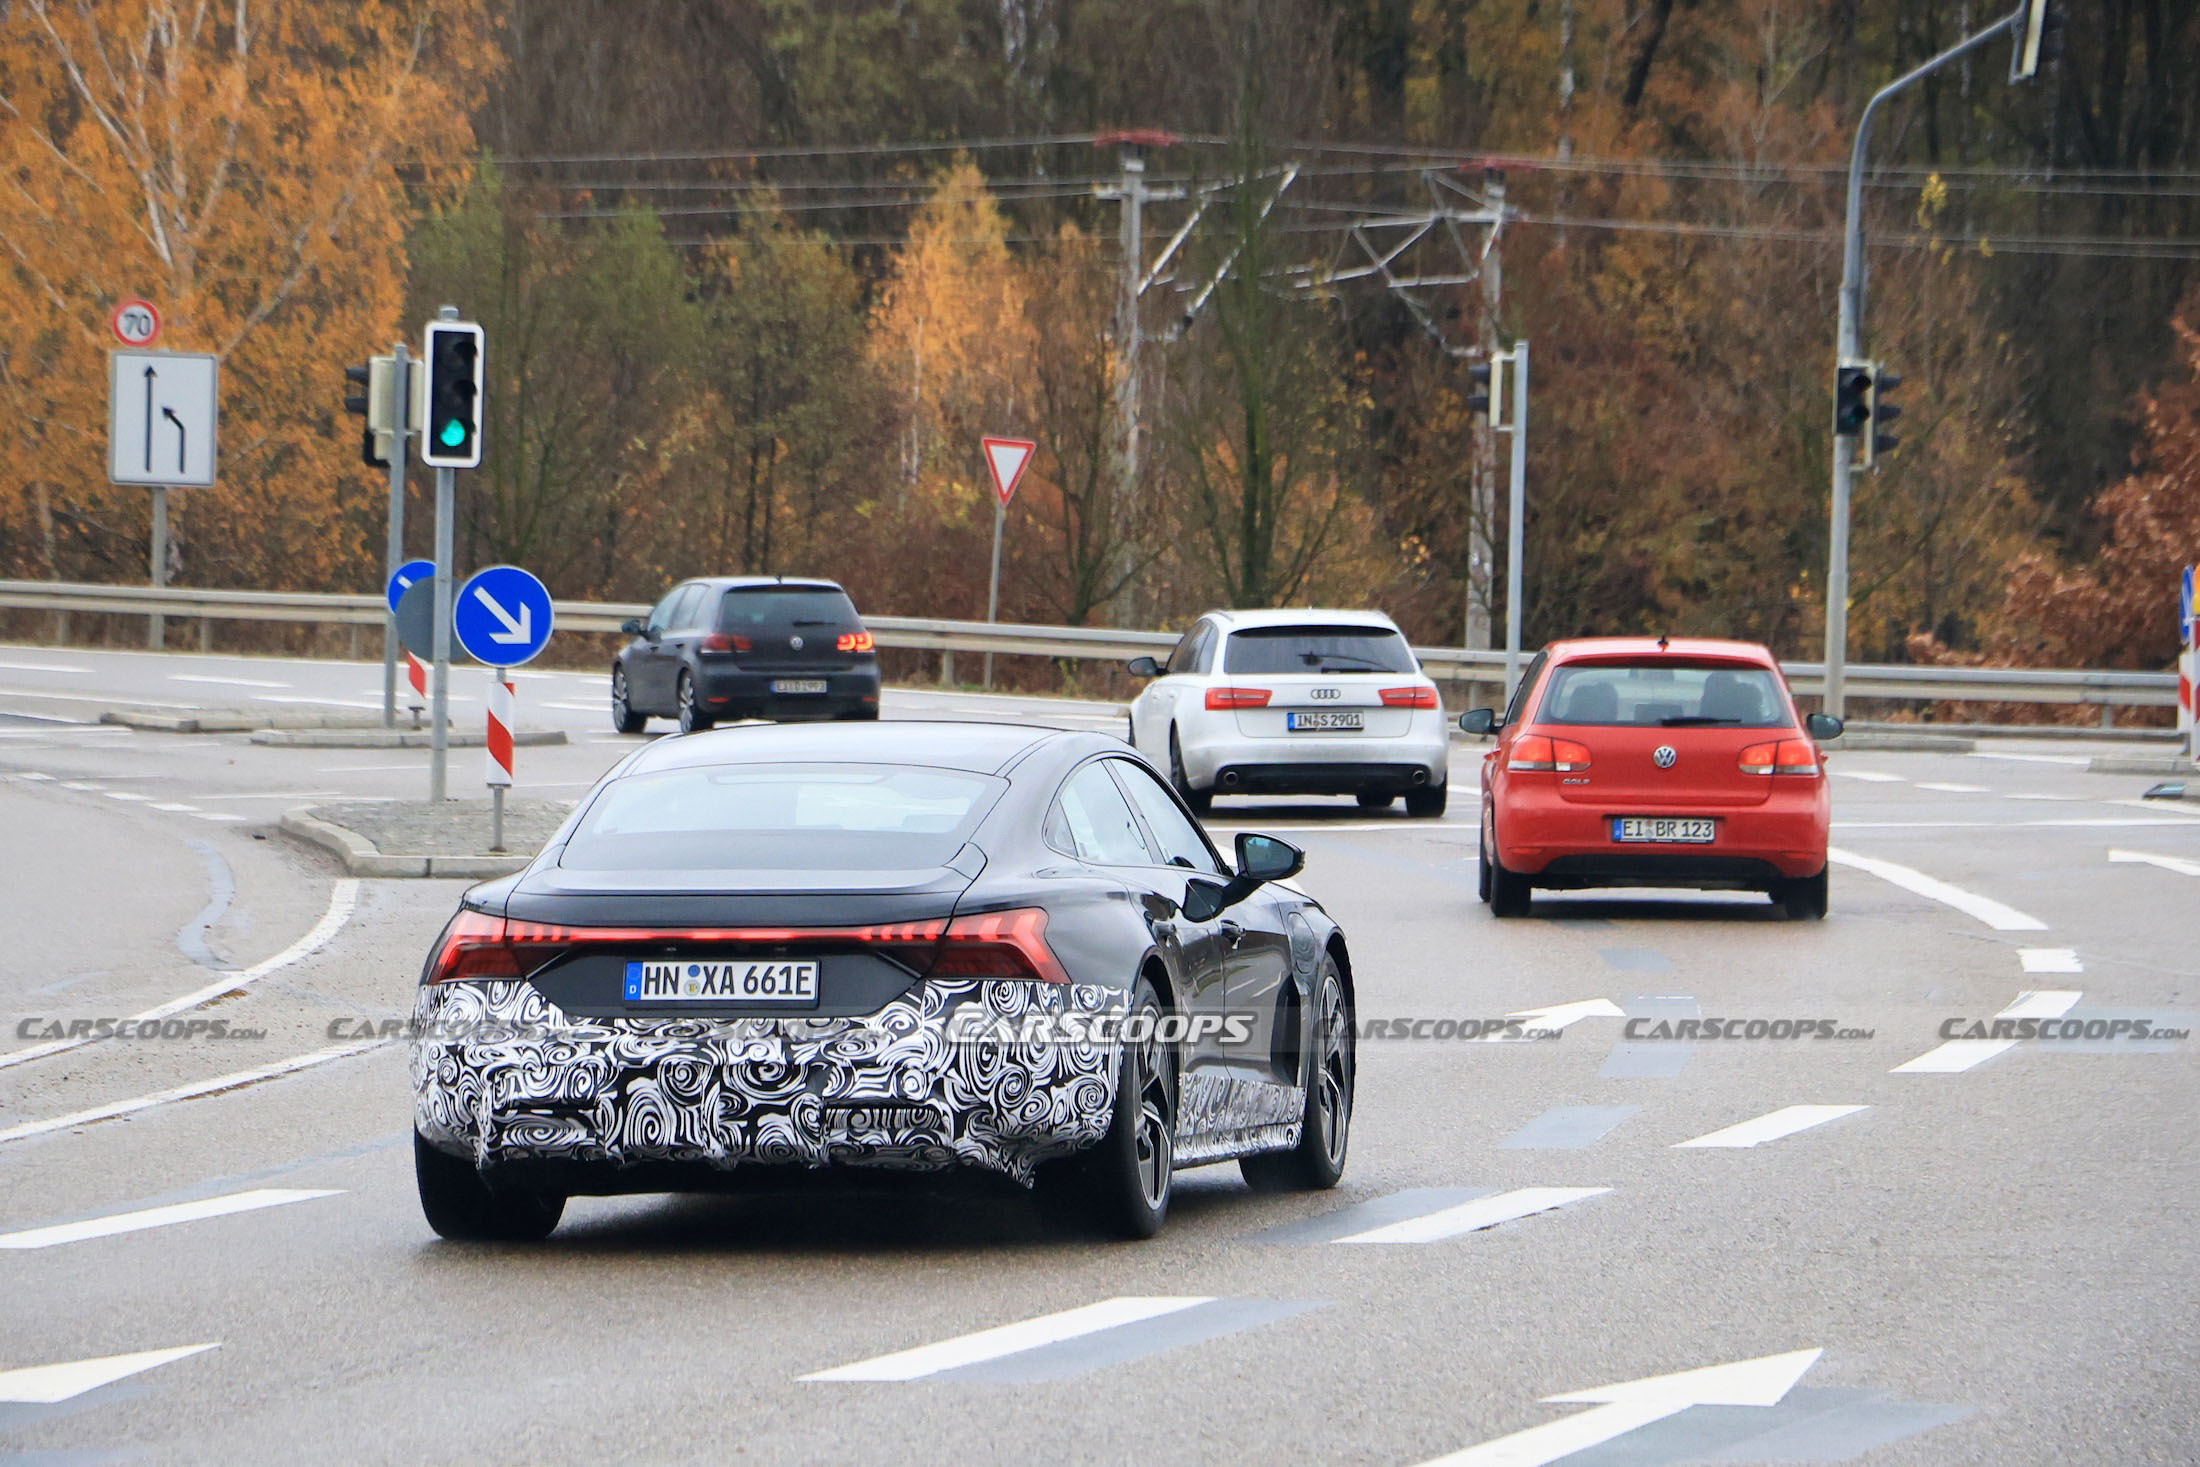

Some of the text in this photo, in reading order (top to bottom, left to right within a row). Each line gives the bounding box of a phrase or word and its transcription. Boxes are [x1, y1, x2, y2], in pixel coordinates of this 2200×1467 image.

[122, 313, 151, 336] 70
[1297, 714, 1361, 727] IN S 2901
[1623, 821, 1713, 838] EI BR 123
[644, 966, 812, 995] HN XA 661E
[629, 986, 637, 994] D
